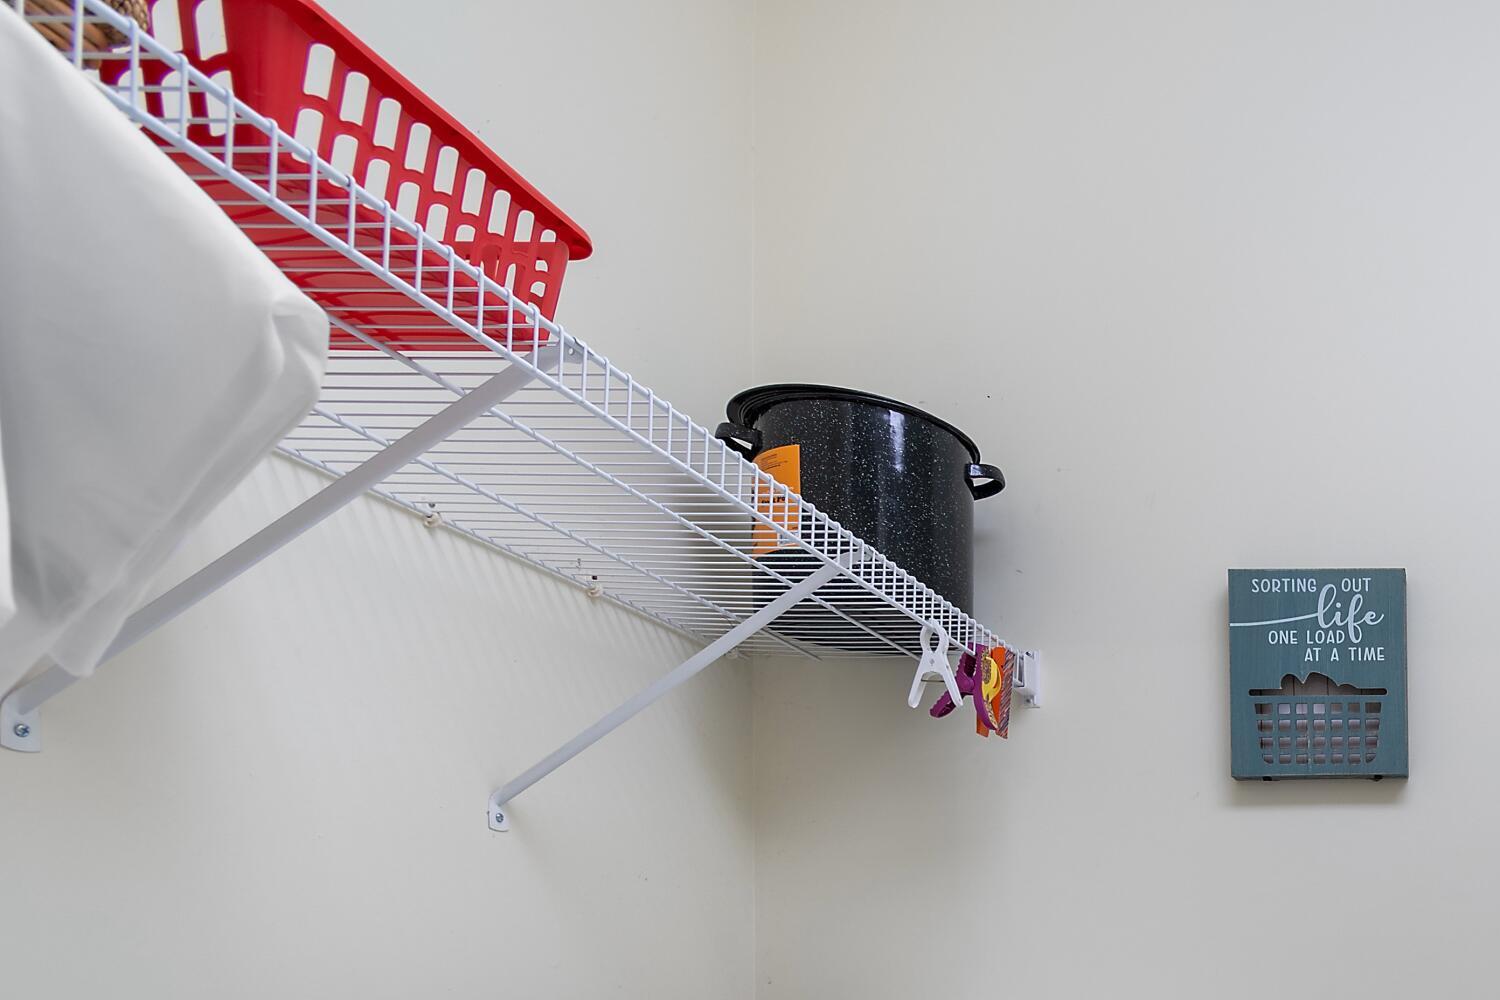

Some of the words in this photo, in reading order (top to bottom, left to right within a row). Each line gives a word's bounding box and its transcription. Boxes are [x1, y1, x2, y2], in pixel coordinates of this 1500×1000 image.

[1251, 578, 1317, 592] SORTING
[1341, 577, 1372, 592] OUT
[1317, 583, 1385, 644] life
[1268, 630, 1298, 645] ONE
[1306, 630, 1345, 645] LOAD
[1304, 647, 1321, 661] AT
[1330, 648, 1339, 661] A
[1348, 647, 1385, 661] TIME
